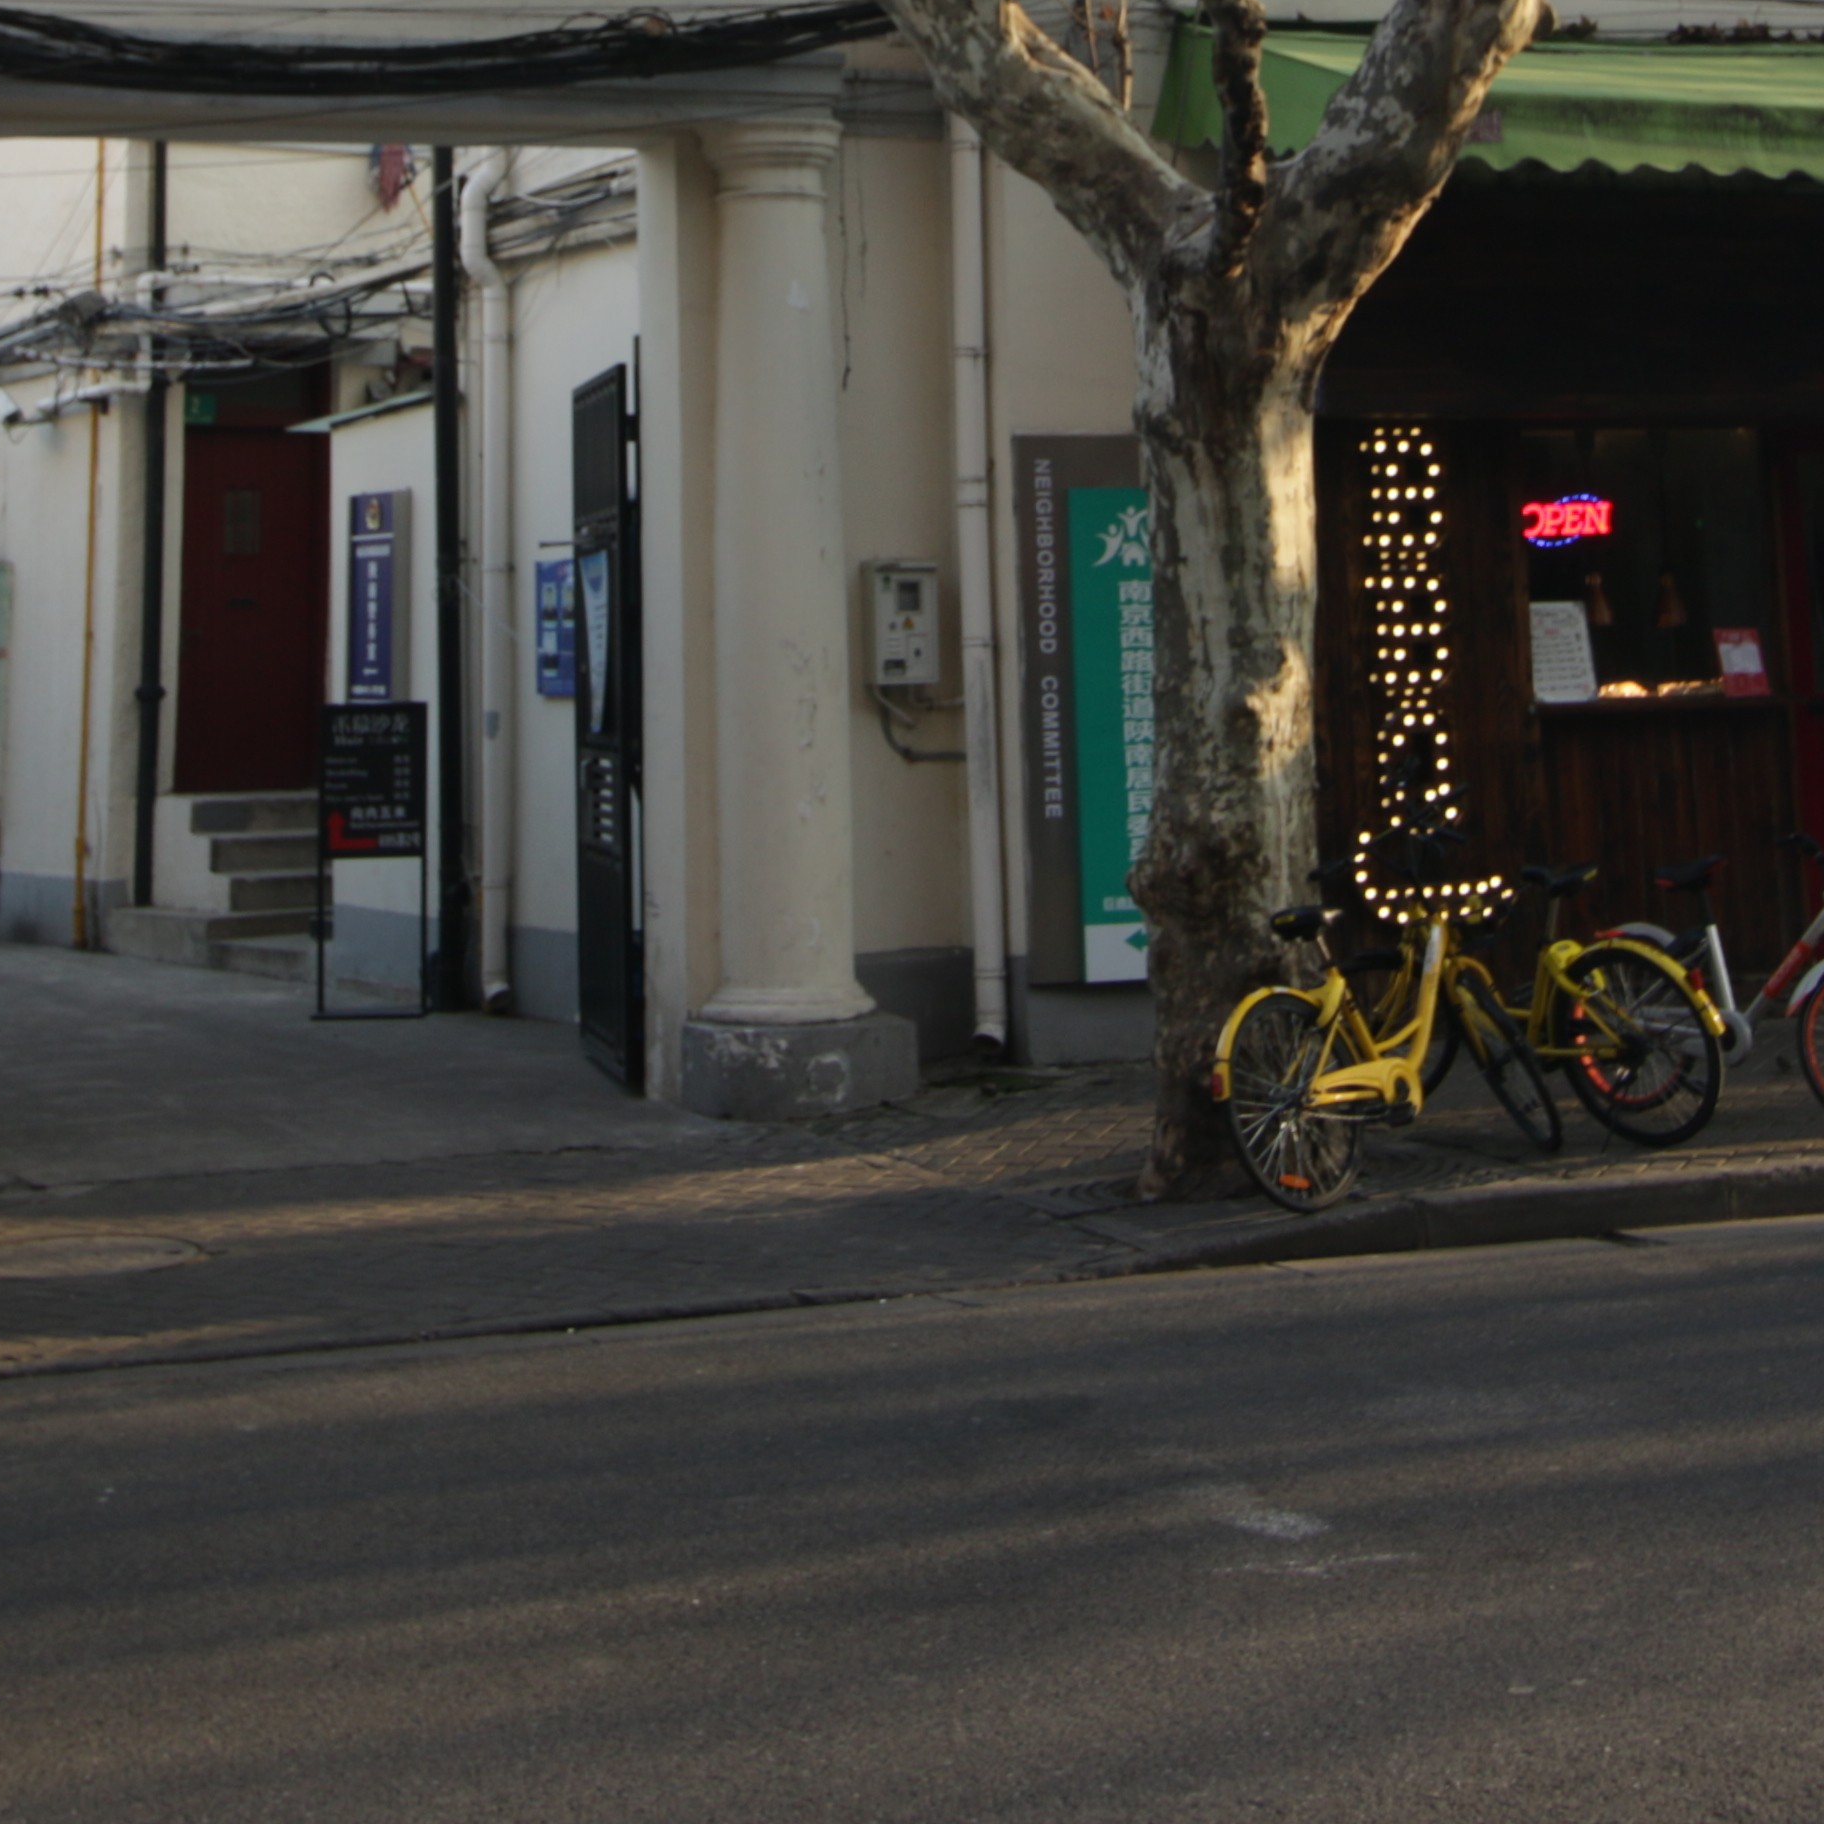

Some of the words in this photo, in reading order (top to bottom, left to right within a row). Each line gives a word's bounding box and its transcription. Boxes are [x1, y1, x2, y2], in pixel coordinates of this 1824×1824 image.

[1033, 457, 1058, 655] NEIGHBORHOOD
[1521, 499, 1612, 539] OPEN
[1040, 675, 1065, 820] COMMITTEE
